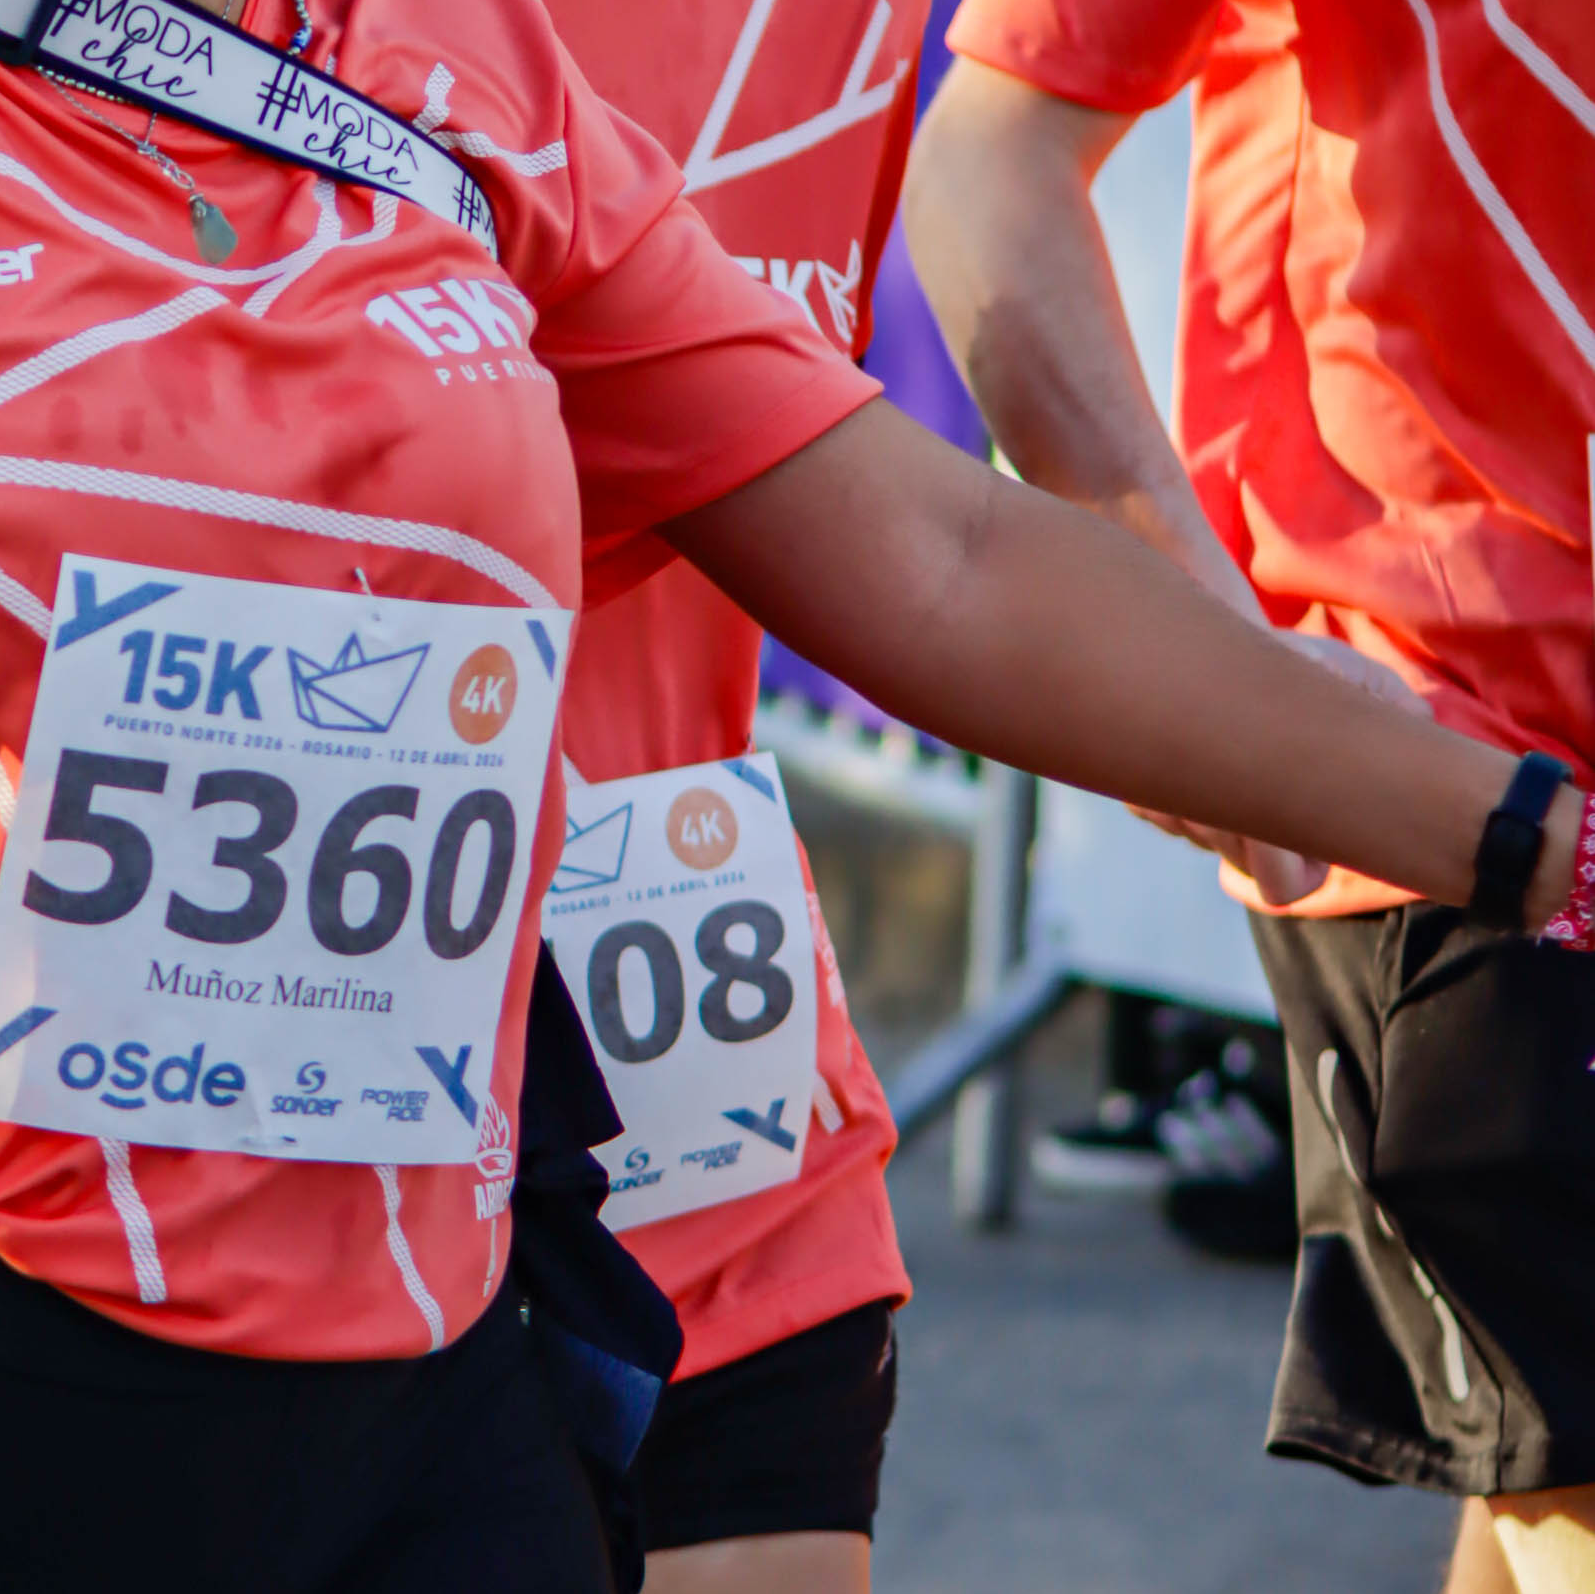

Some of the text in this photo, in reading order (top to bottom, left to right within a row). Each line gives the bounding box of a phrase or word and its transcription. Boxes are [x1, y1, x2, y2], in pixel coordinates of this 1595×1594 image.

[80, 27, 197, 98] chic
[256, 60, 420, 172] #MODA
[303, 121, 412, 186] chic
[365, 277, 524, 358] 15K
[119, 629, 274, 721] 15K
[461, 675, 507, 715] 4K
[103, 714, 175, 737] PUERTO
[180, 726, 237, 746] NORTE
[243, 735, 284, 751] 2026
[301, 740, 372, 761] ROSARIO
[388, 749, 402, 763] 12
[405, 750, 429, 765] DE
[433, 751, 470, 767] ABRIL
[21, 746, 517, 961] 5360
[679, 808, 727, 846] 4K
[144, 959, 394, 1014] Muñoz Marilina
[546, 898, 794, 1065] 08
[57, 1041, 247, 1109] osde
[360, 1088, 430, 1105] POWER
